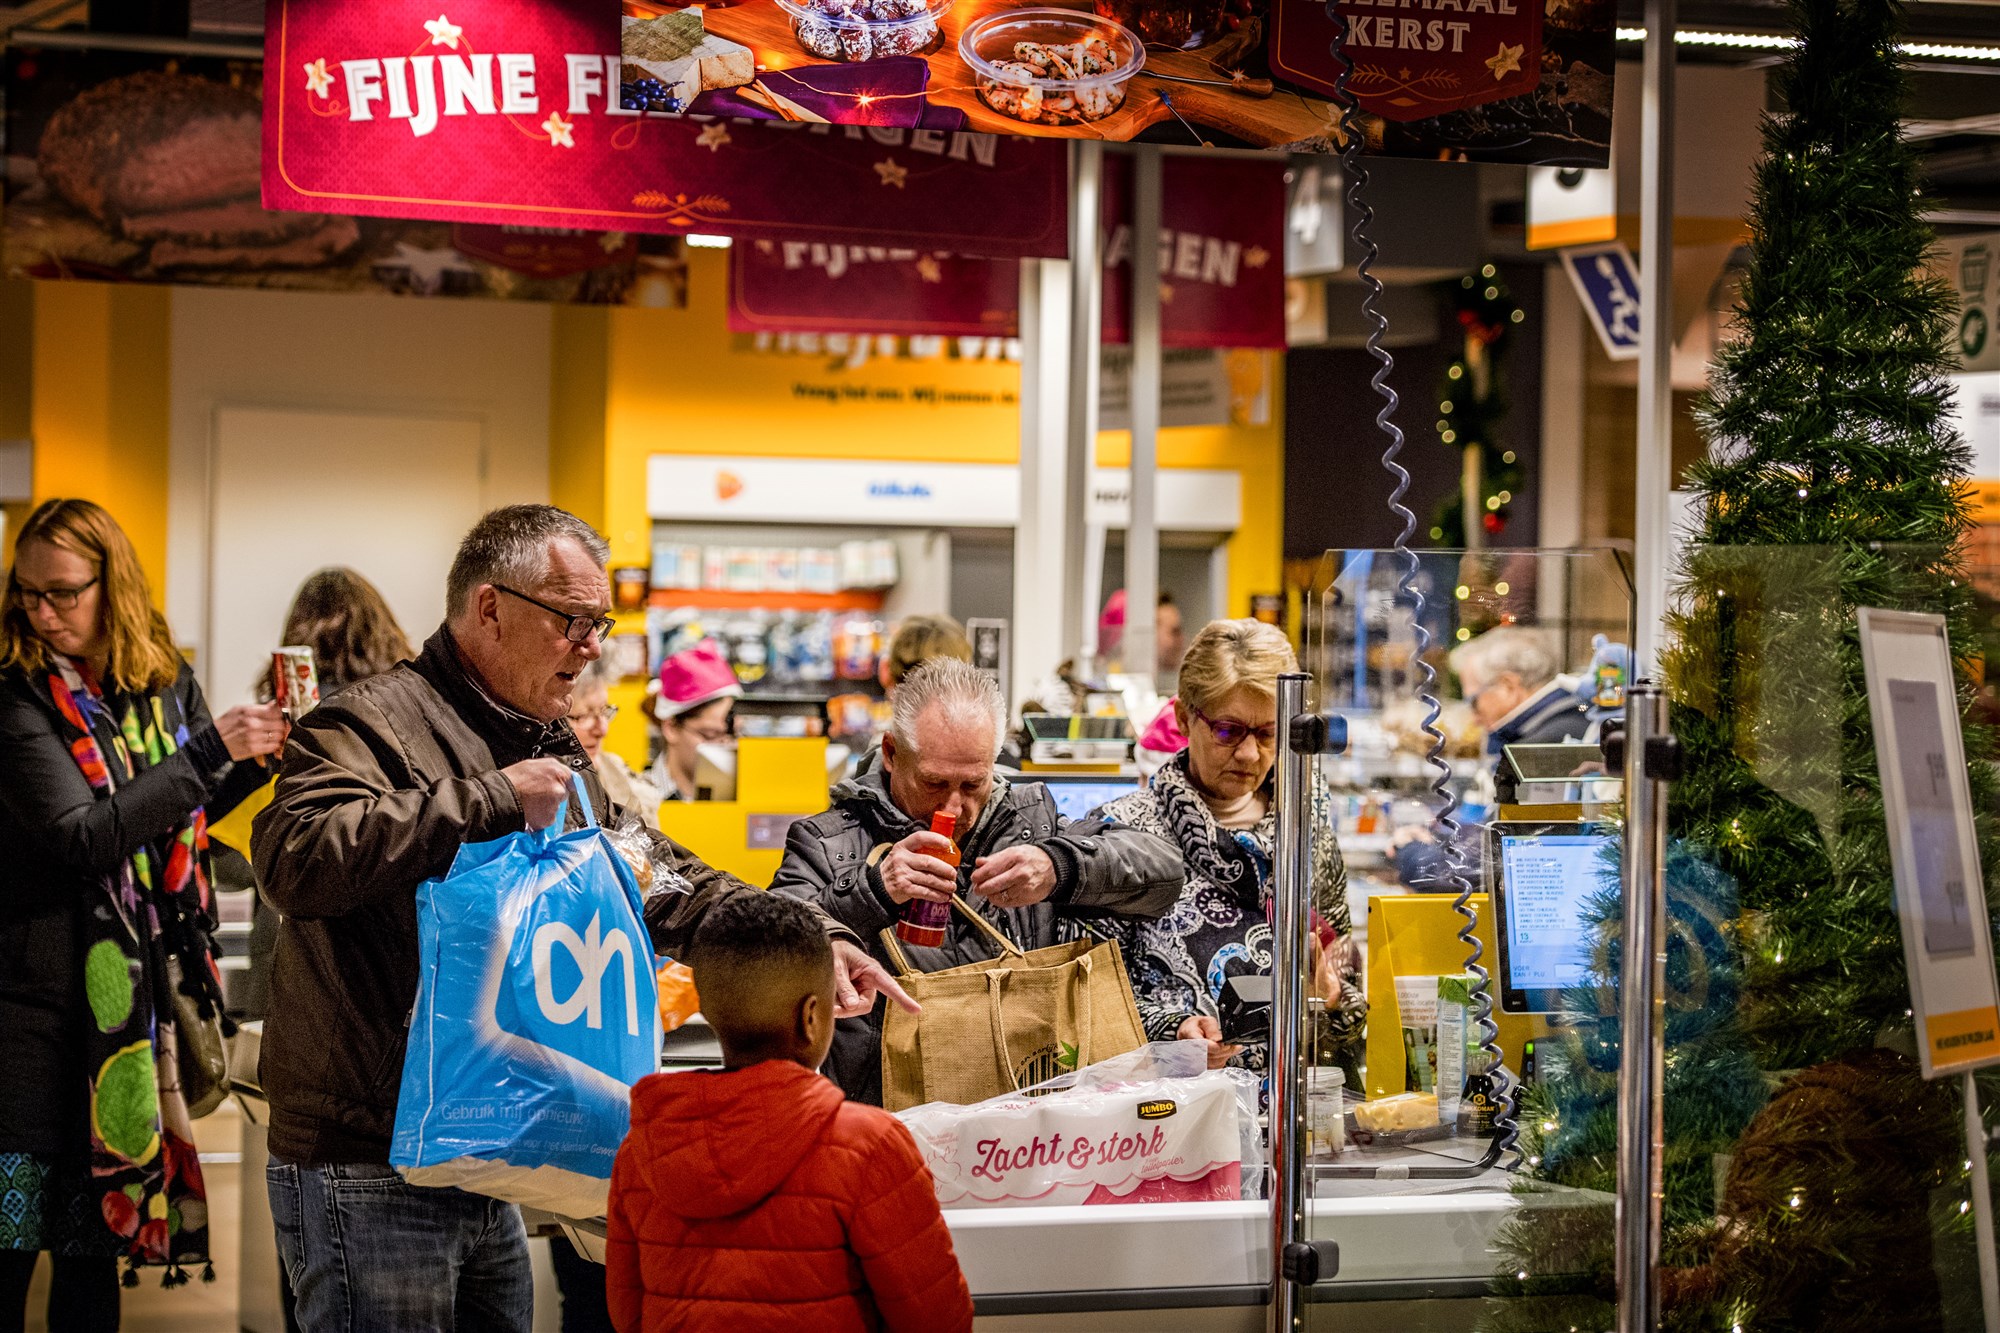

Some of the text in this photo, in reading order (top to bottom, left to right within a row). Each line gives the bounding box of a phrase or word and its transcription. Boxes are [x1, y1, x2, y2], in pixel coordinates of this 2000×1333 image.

[1345, 15, 1471, 53] KERST
[340, 53, 539, 137] FIJNE
[1519, 932, 1529, 940] 13
[441, 1103, 495, 1121] Gebruik
[499, 1102, 522, 1122] mij
[1140, 1103, 1175, 1115] JUMBO
[971, 1125, 1168, 1183] Zacht & sterk
